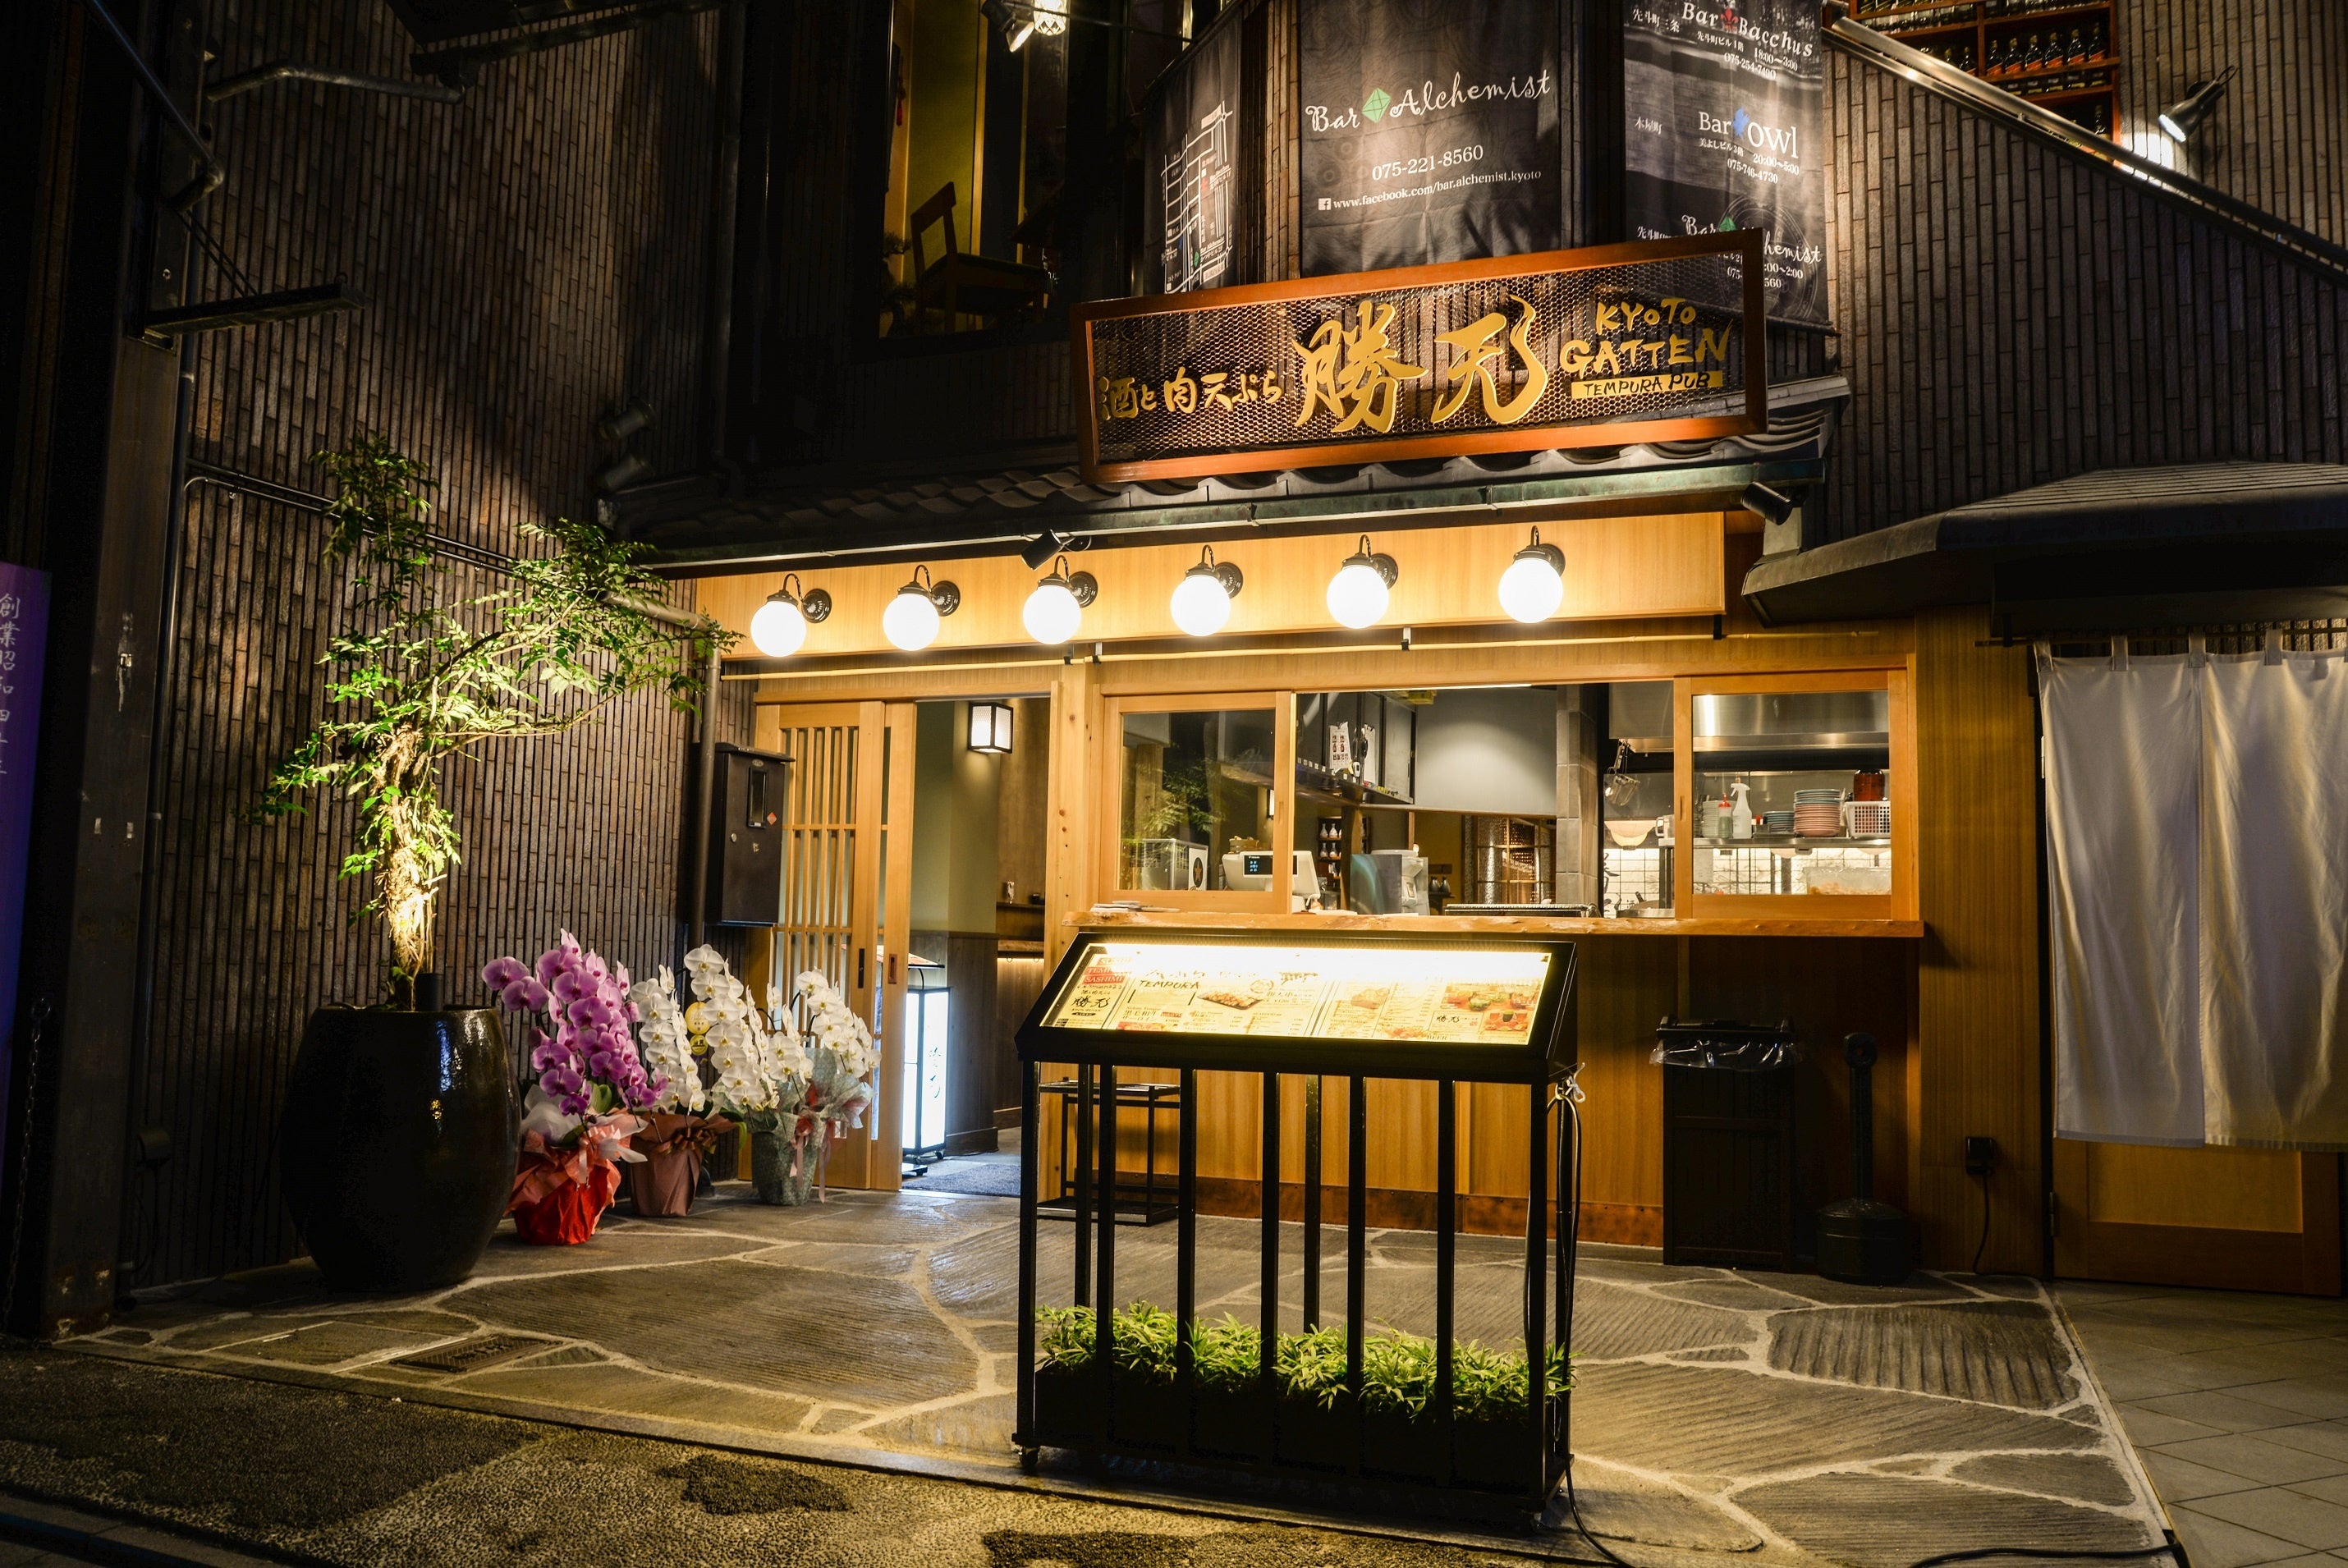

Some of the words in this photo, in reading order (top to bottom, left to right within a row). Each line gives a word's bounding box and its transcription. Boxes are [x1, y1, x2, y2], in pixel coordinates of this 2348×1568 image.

[1681, 2, 1719, 27] Bar
[1738, 16, 1814, 57] Bacchus
[1305, 105, 1360, 132] Bar
[1389, 69, 1550, 117] Alchemist
[1699, 111, 1731, 135] Bar
[1372, 144, 1484, 181] 075-221-8560
[1727, 158, 1778, 184] 075-746-4730
[1333, 170, 1542, 209] www.facebook.com/bar.alchemist.kyoto
[1595, 298, 1697, 335] KYOTO
[1560, 319, 1734, 377] GATTEN
[1098, 367, 1285, 421] 酒と肉天ぷら
[1583, 378, 1662, 397] TEMPURA
[1668, 370, 1711, 390] PUB
[1139, 979, 1199, 989] TEMPURA
